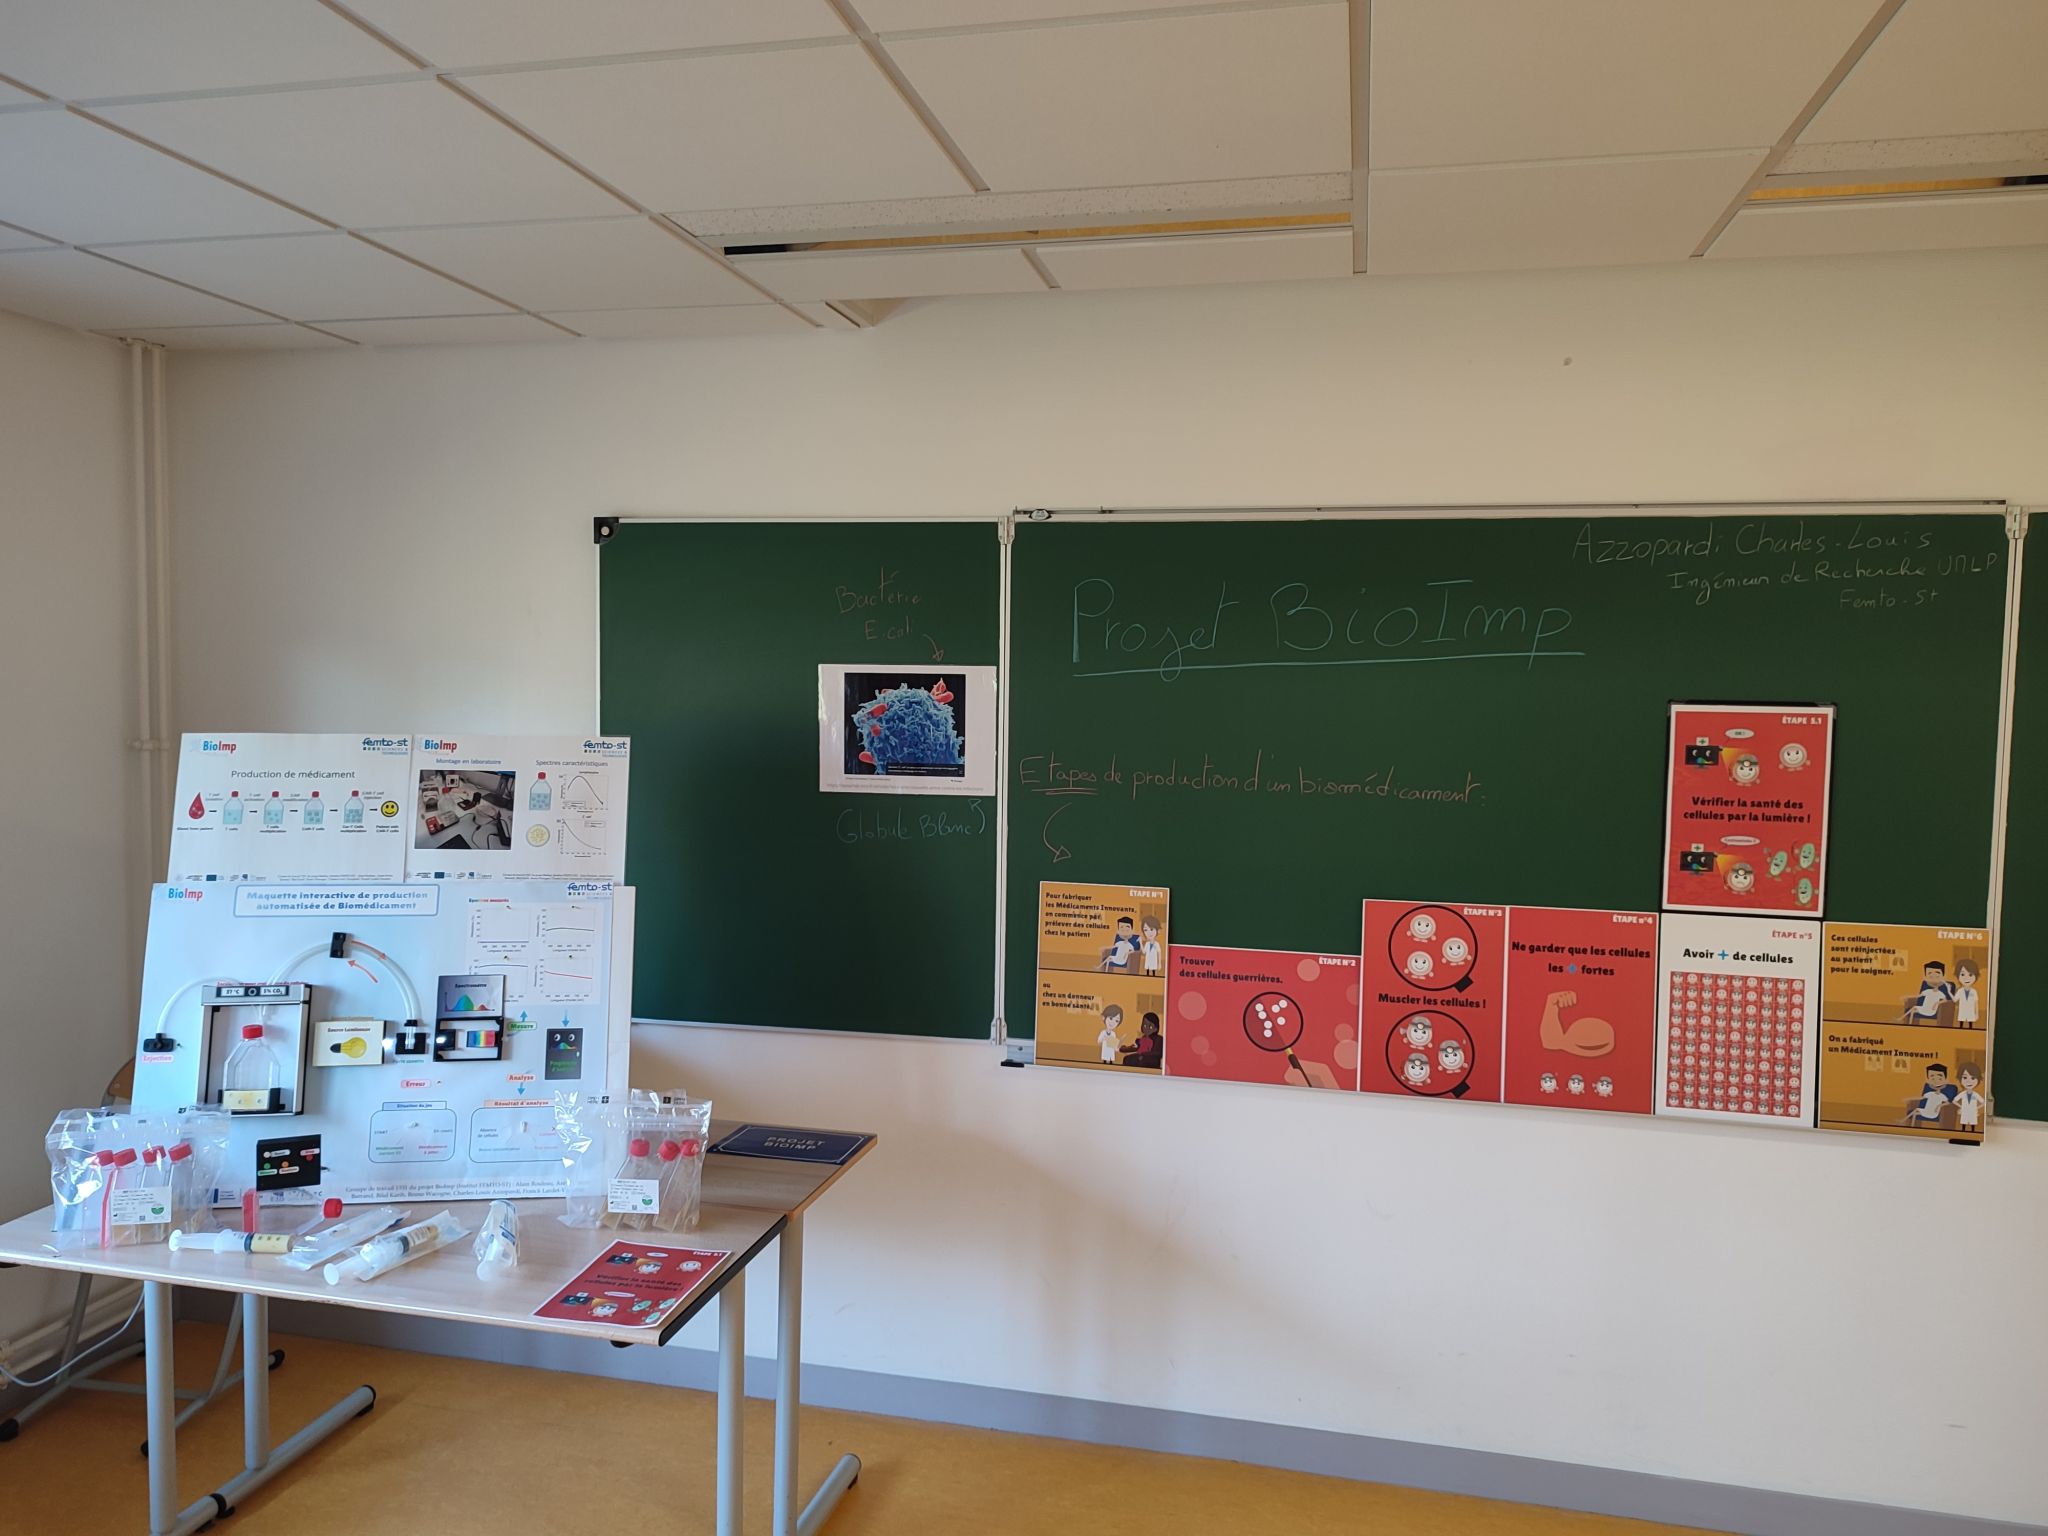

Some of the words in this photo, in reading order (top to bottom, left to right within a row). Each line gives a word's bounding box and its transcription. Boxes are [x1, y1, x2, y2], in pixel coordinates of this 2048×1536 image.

[1572, 522, 1723, 566] Azzopardi
[1781, 562, 1808, 583] de
[1815, 557, 1926, 580] Recherche
[1073, 578, 1240, 682] Projet
[1270, 579, 1573, 671] BioImp
[1782, 716, 1807, 724] ÉTAPE
[1810, 716, 1822, 724] 5.1
[202, 740, 237, 754] BioImp
[362, 737, 408, 747] femto-st
[424, 740, 457, 752] BioImp
[583, 740, 627, 750] femto-st
[562, 760, 608, 768] caractéristiques
[231, 770, 282, 779] Production
[284, 770, 296, 779] de
[298, 770, 355, 779] médicament
[1019, 752, 1097, 788] Etapes
[1104, 752, 1122, 784] de
[1132, 753, 1238, 800] production
[1244, 749, 1291, 791] d'un
[1692, 796, 1735, 807] Vérifier
[1738, 798, 1747, 808] la
[1750, 799, 1781, 809] santé
[1784, 800, 1803, 809] des
[1684, 810, 1725, 820] cellules
[1728, 813, 1746, 823] par
[1748, 812, 1759, 822] la
[1762, 812, 1805, 823] lumière
[1807, 814, 1810, 823] !
[836, 807, 911, 843] Globule
[919, 814, 972, 838] Blanc
[168, 888, 203, 901] BioImp
[567, 882, 613, 891] femto-st
[247, 892, 298, 901] Maquette
[300, 891, 356, 900] interactive
[358, 892, 369, 900] de
[372, 891, 428, 901] production
[1062, 892, 1092, 901] fabriquer
[1130, 889, 1150, 898] ÉTAPE
[256, 902, 321, 910] automatisée
[322, 902, 336, 910] de
[338, 902, 416, 910] Biomédicament
[1056, 901, 1100, 911] Médicaments
[1054, 912, 1088, 920] commence
[1464, 907, 1487, 916] ÉTAPE
[1612, 914, 1638, 923] ÉTAPE
[1045, 920, 1072, 929] prélever
[1086, 922, 1110, 930] cellules
[1067, 930, 1090, 938] patient
[1772, 930, 1797, 939] ÉTAPE
[1831, 934, 1845, 942] Ces
[1847, 935, 1878, 943] cellules
[1938, 930, 1965, 940] ÉTAPE
[1512, 941, 1526, 951] Ne
[1529, 944, 1566, 954] garder
[1568, 947, 1588, 956] que
[1590, 946, 1606, 956] les
[1609, 948, 1651, 958] cellules
[1851, 945, 1896, 955] réinjectées
[1319, 956, 1342, 966] ÉTAPE
[1683, 948, 1714, 959] Avoir
[1732, 952, 1747, 961] de
[1750, 953, 1794, 964] cellules
[1843, 956, 1873, 964] patient
[1180, 956, 1215, 967] Trouver
[1548, 963, 1564, 973] les
[1582, 965, 1615, 976] fortes
[1831, 966, 1849, 974] pour
[1860, 967, 1894, 976] soigner.
[1179, 970, 1195, 978] des
[1197, 971, 1231, 981] cellules
[1233, 973, 1283, 984] guerrières.
[1068, 992, 1095, 1001] donneur
[1378, 993, 1422, 1005] Muscler
[1424, 996, 1438, 1005] les
[1440, 997, 1480, 1008] cellules
[1483, 999, 1486, 1009] !
[1051, 1000, 1071, 1008] bonne
[1828, 1034, 1841, 1043] On
[1849, 1036, 1884, 1046] fabriqué
[1841, 1046, 1893, 1056] Médicament
[1894, 1049, 1934, 1059] Innovant
[764, 1142, 817, 1150] BIOIMP
[768, 1136, 825, 1146] PROJET
